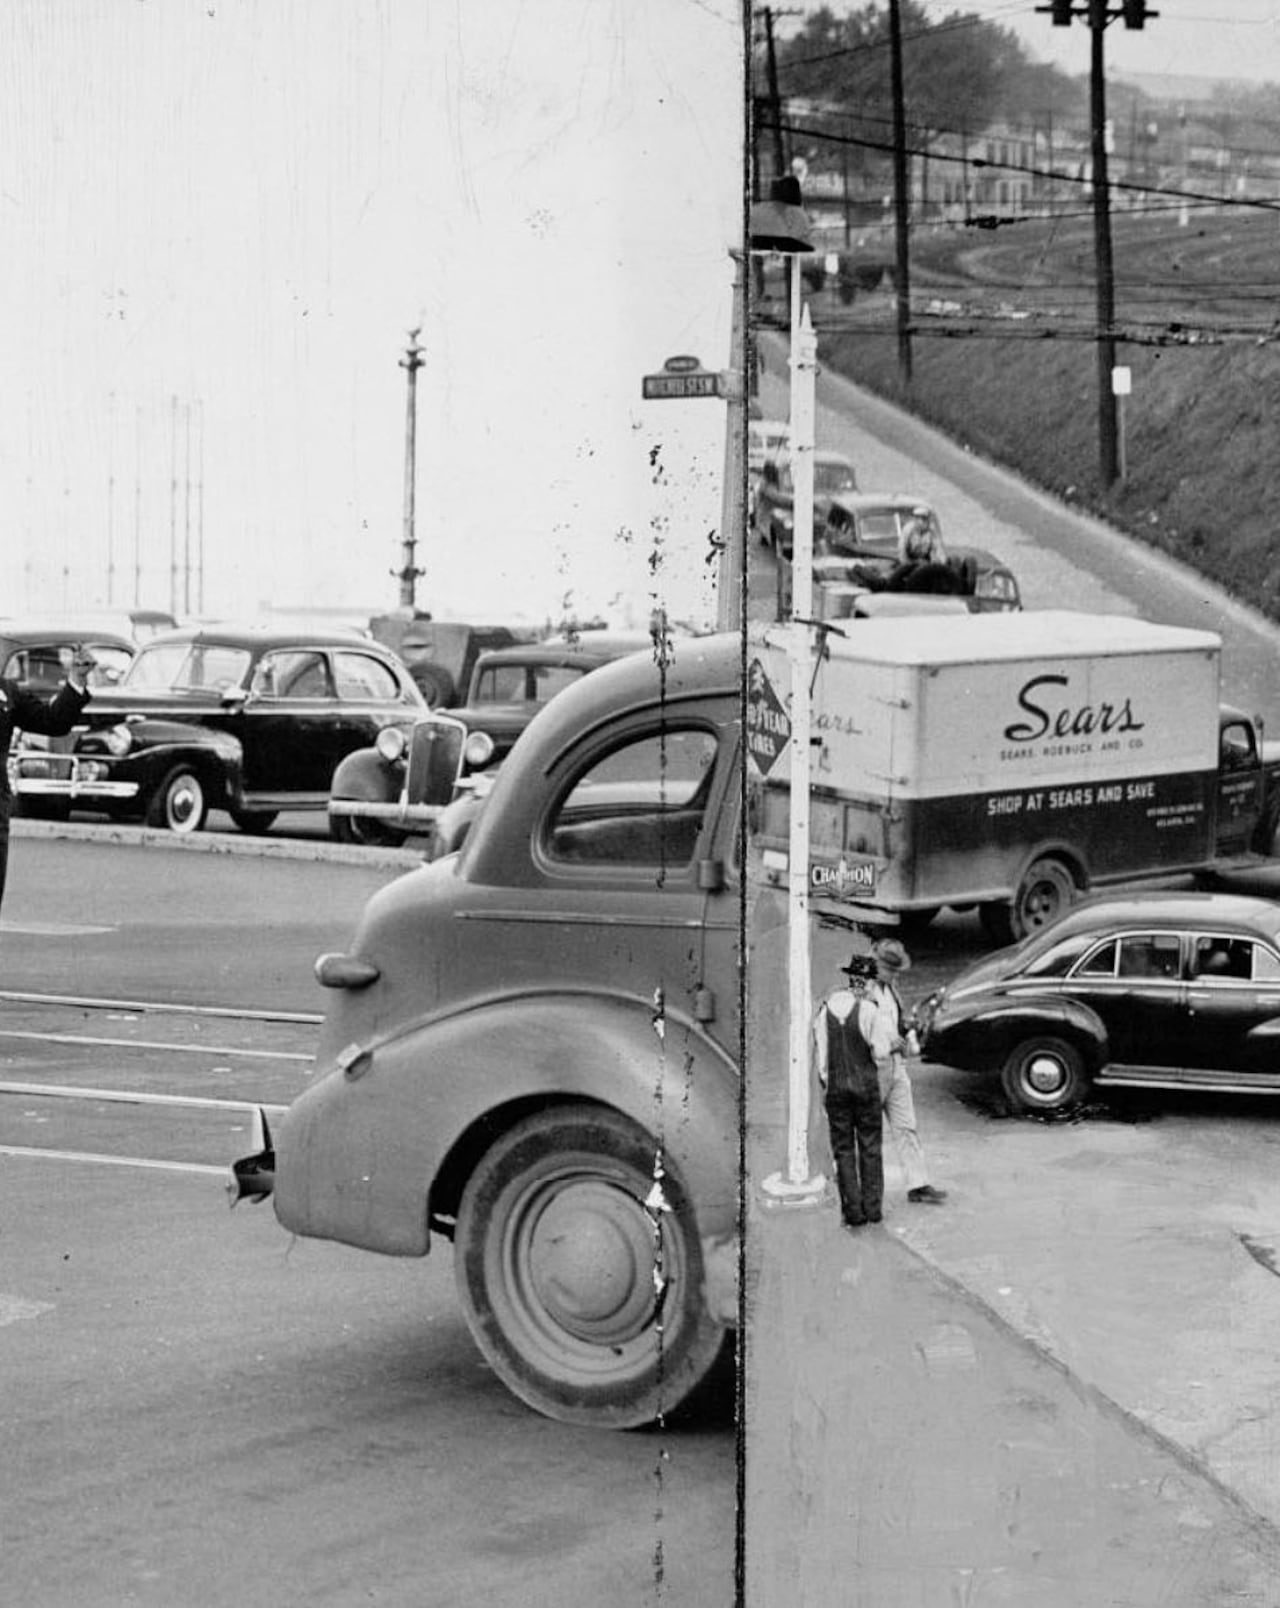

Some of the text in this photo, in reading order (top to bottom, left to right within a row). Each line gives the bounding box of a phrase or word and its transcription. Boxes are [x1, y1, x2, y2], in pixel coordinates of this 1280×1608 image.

[1004, 674, 1145, 742] Sears
[1043, 743, 1092, 756] ROEBUCK
[1101, 740, 1120, 750] AND
[987, 782, 1156, 816] SHOP AT SEARS AND SAVE
